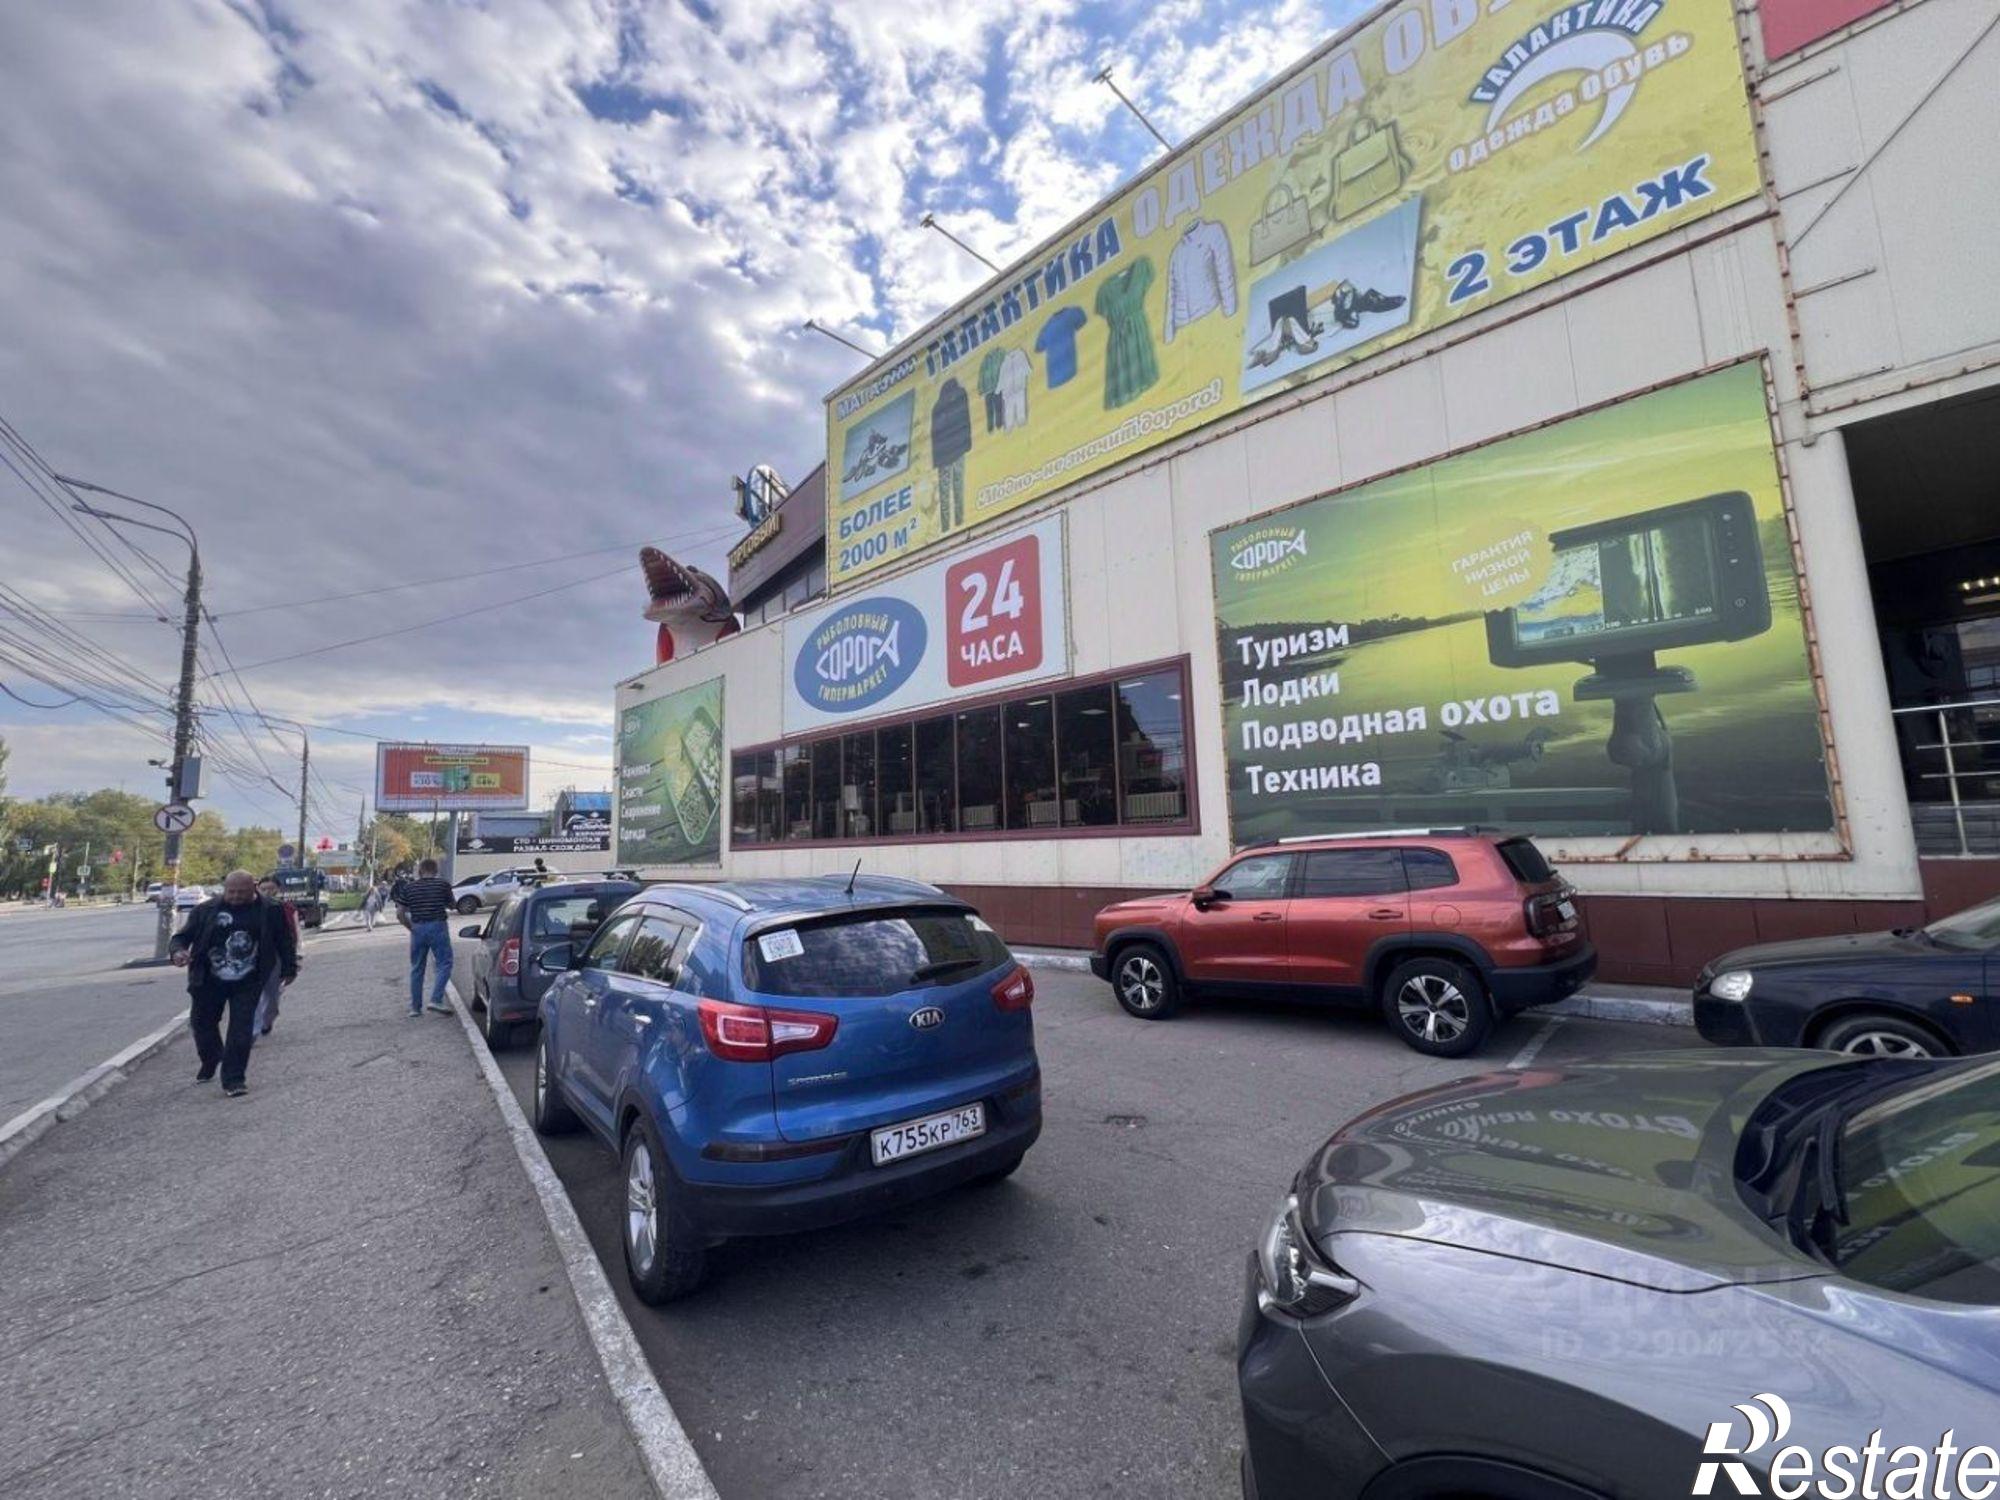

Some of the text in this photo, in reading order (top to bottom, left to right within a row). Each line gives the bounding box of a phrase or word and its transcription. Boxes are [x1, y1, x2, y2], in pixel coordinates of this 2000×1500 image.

[1472, 0, 1662, 102] ГАЛАКТИКА
[1580, 35, 1692, 101] Обувь
[925, 216, 1121, 377] ГАЛАКТИКА
[1132, 52, 1368, 238] ОДЕЖДА
[1383, 0, 1512, 76] ОБ
[1447, 156, 1712, 304] 2 ЭТАЖ
[840, 485, 912, 539] БОЛЕЕ
[840, 532, 887, 572] 2000
[1230, 529, 1307, 569] СОРОГА
[1452, 530, 1533, 573] ГАРАНТИЯ
[960, 559, 1024, 634] 24
[1481, 568, 1531, 597] ЦЕНЫ
[815, 620, 900, 681] СОРОГА
[817, 613, 890, 650] РЫБОЛОВНЫЙ
[961, 631, 1024, 668] ЧАСА
[1237, 624, 1349, 671] Туризм
[818, 664, 888, 702] ГИПЕРМАРКЕТ
[1242, 671, 1340, 708] Лодки
[1242, 690, 1560, 750] Подводная охота
[1245, 762, 1381, 795] Техника
[916, 1011, 940, 1028] KIA
